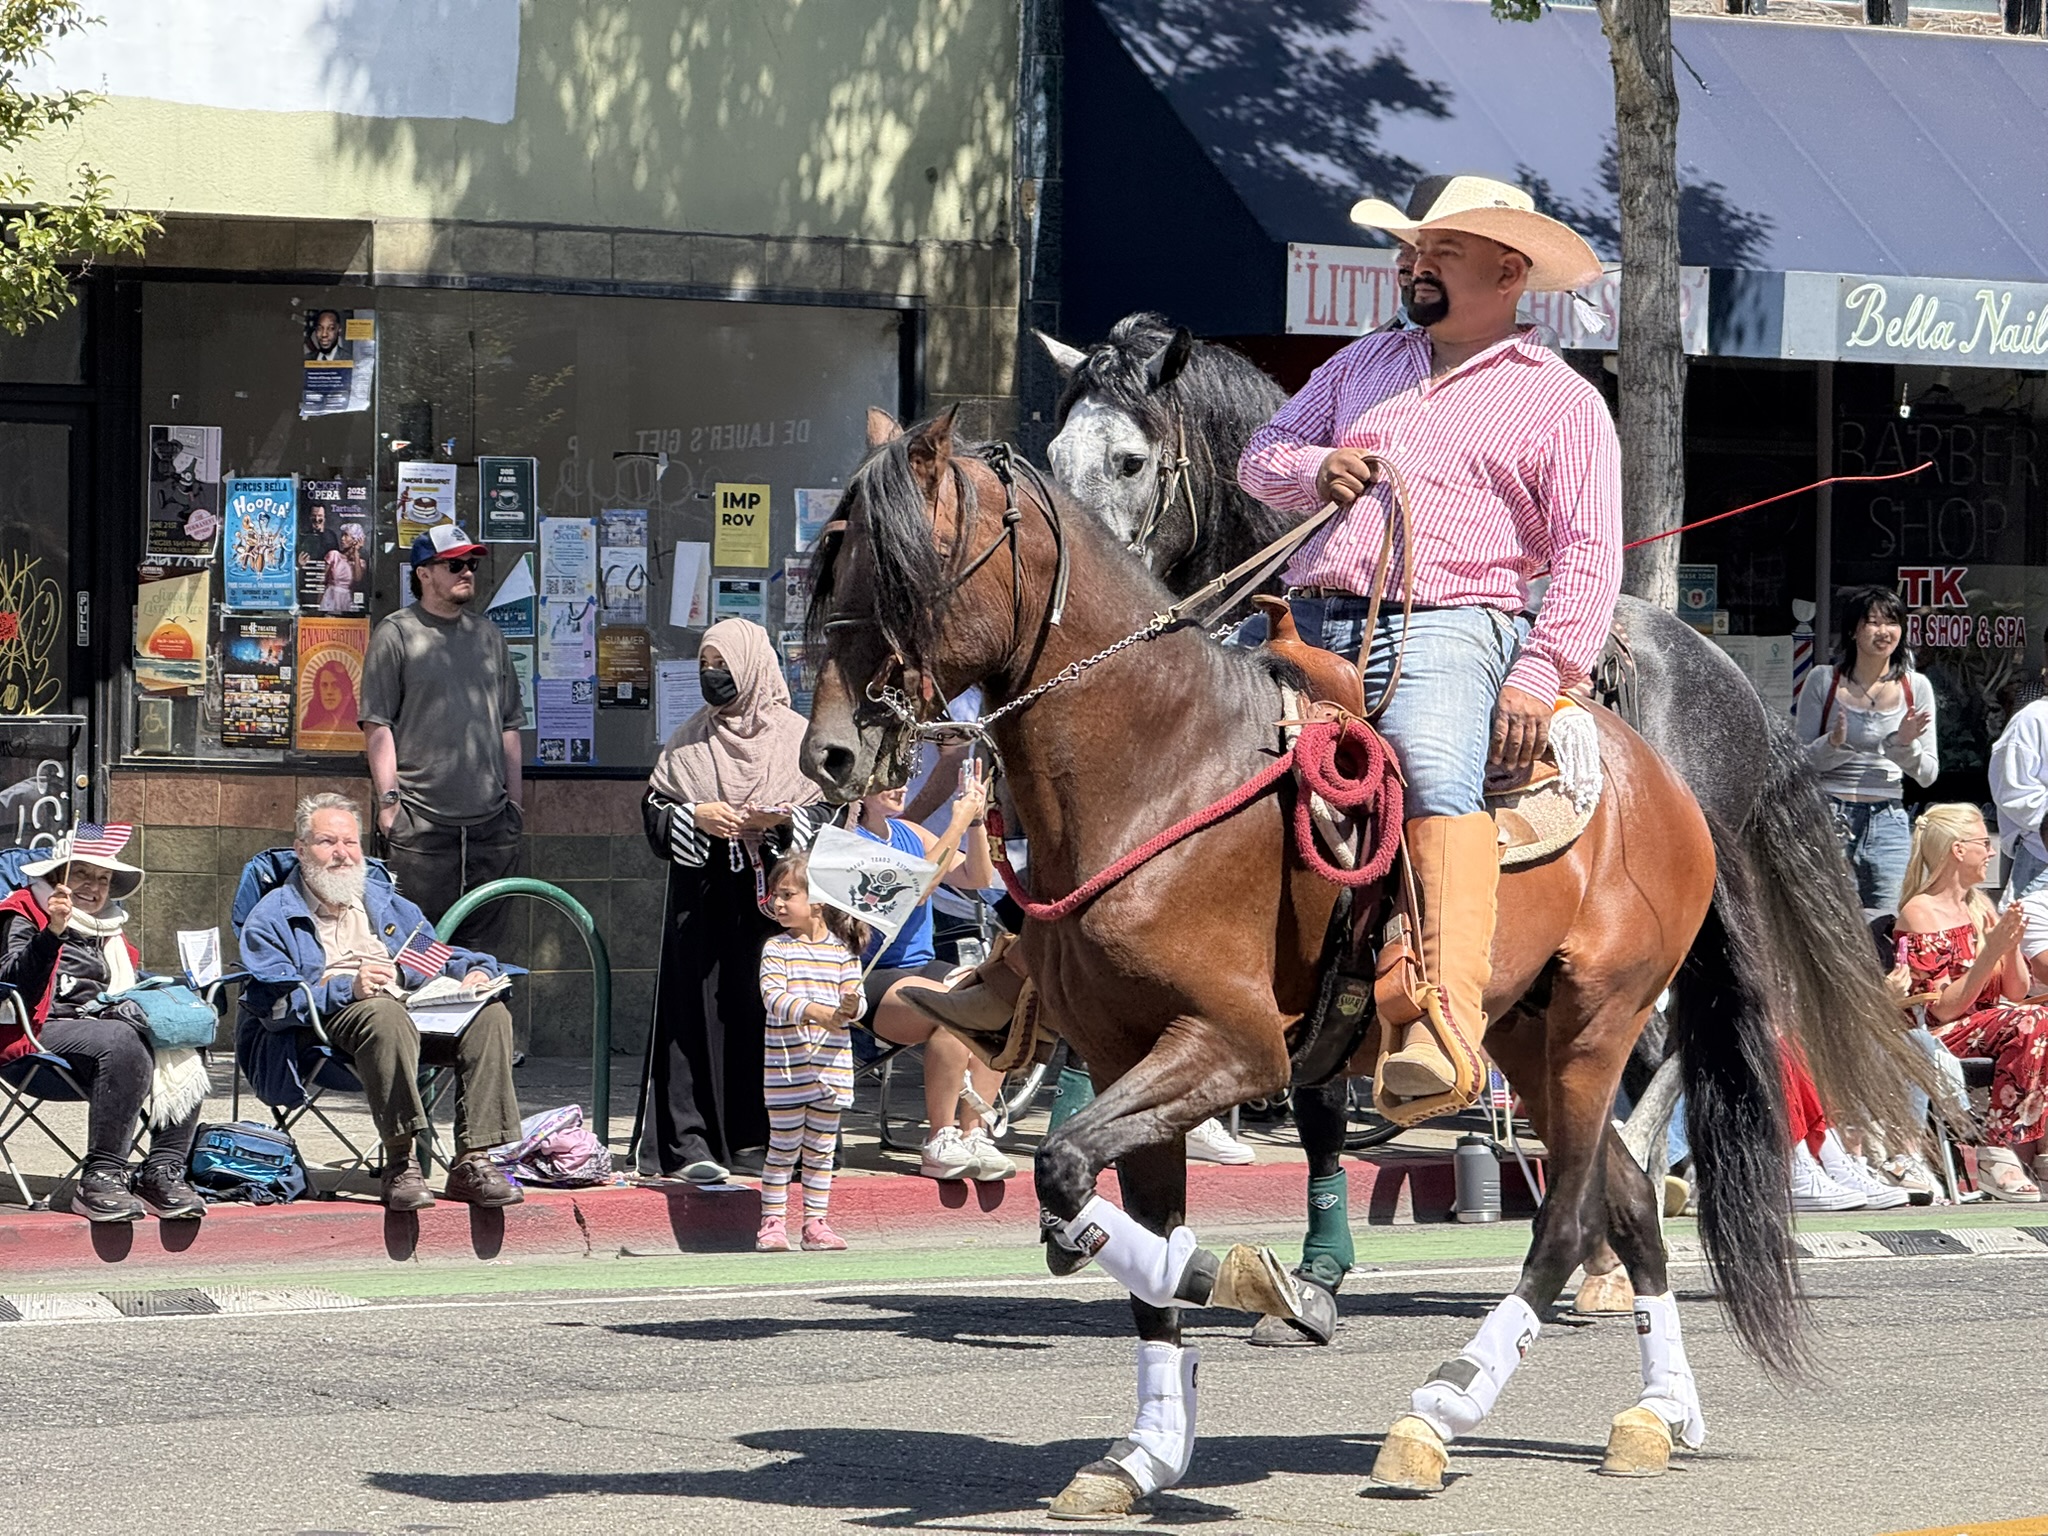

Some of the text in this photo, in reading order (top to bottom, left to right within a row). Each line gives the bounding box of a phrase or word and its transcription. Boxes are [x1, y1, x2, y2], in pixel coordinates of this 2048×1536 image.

[1846, 283, 1956, 351] Bella
[1839, 421, 2040, 486] BARBER
[234, 482, 288, 492] CIRCUS BELLA
[302, 480, 342, 490] POCKET
[347, 486, 367, 495] 2025
[307, 490, 341, 500] OPERA
[722, 492, 761, 510] IMP
[722, 513, 755, 527] ROV
[1869, 497, 2007, 559] SHOP
[1899, 566, 1968, 608] TK
[1926, 614, 1972, 647] SHOP
[1976, 615, 1990, 648] &
[1994, 615, 2027, 648] SPA
[605, 635, 645, 645] SUMMER
